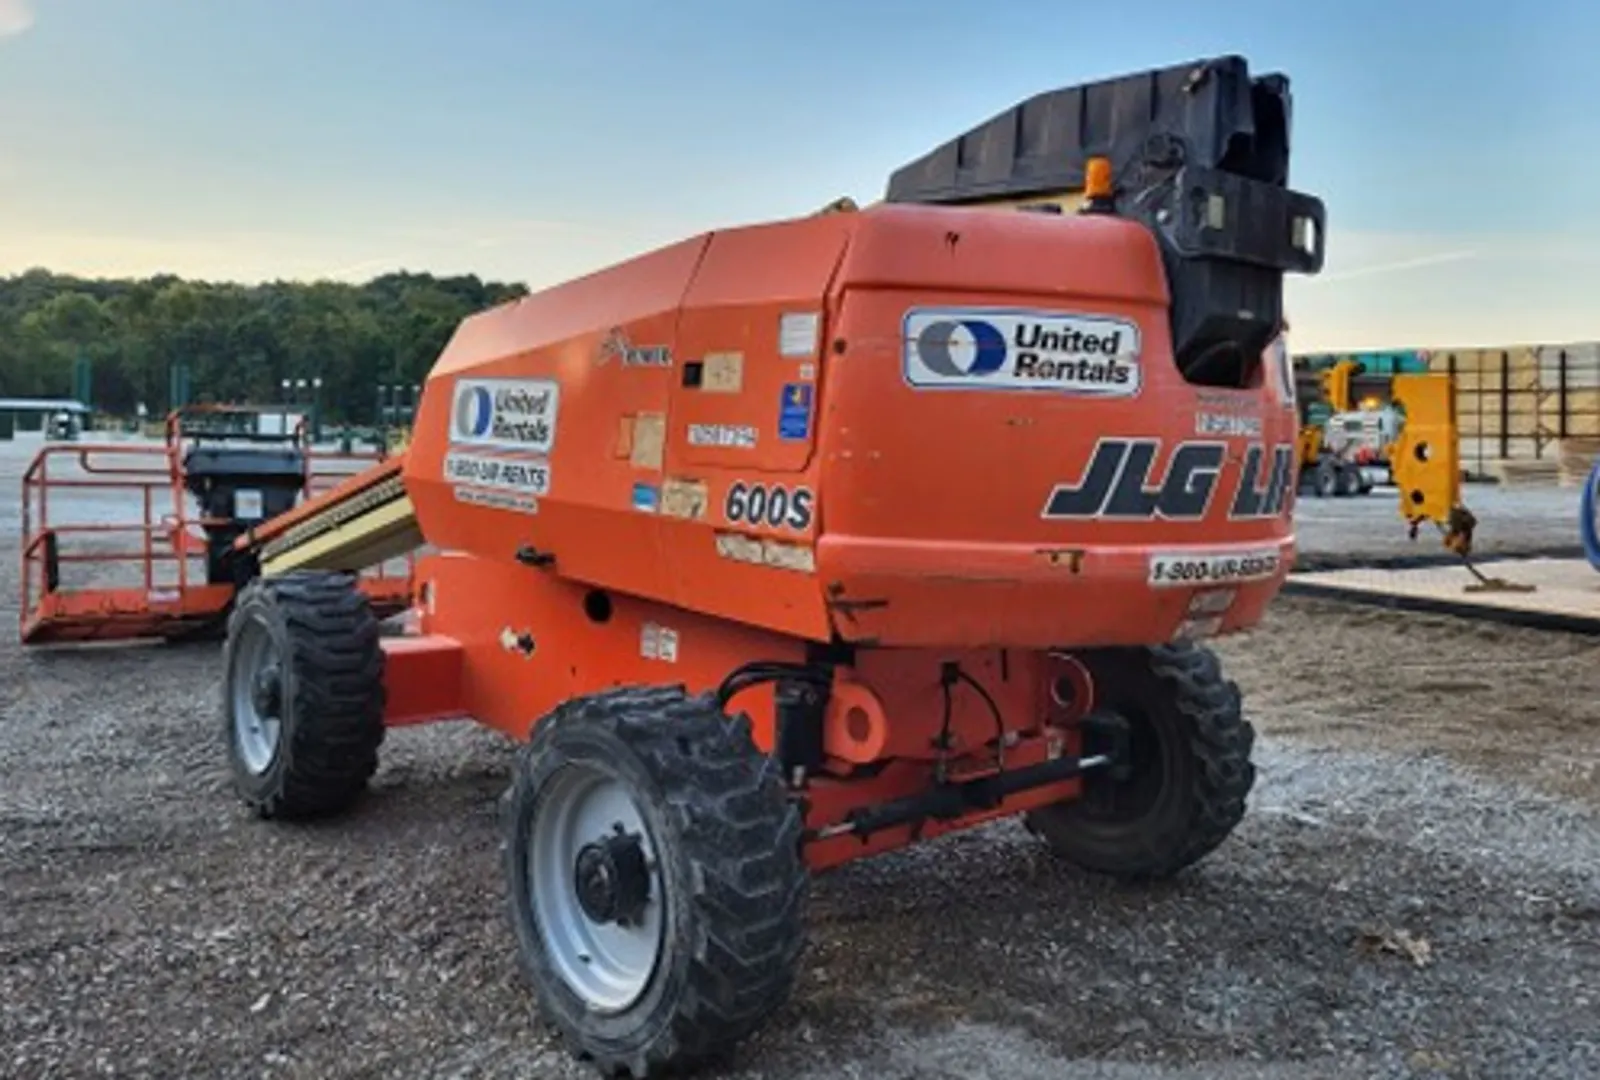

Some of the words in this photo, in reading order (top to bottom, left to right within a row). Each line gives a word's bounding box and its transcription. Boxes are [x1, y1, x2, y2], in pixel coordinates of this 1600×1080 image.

[1013, 324, 1122, 356] United
[1012, 352, 1130, 384] Rentals
[494, 388, 550, 416] United
[493, 415, 549, 445] Rentals
[1042, 437, 1228, 521] JLG
[724, 481, 814, 530] 600S
